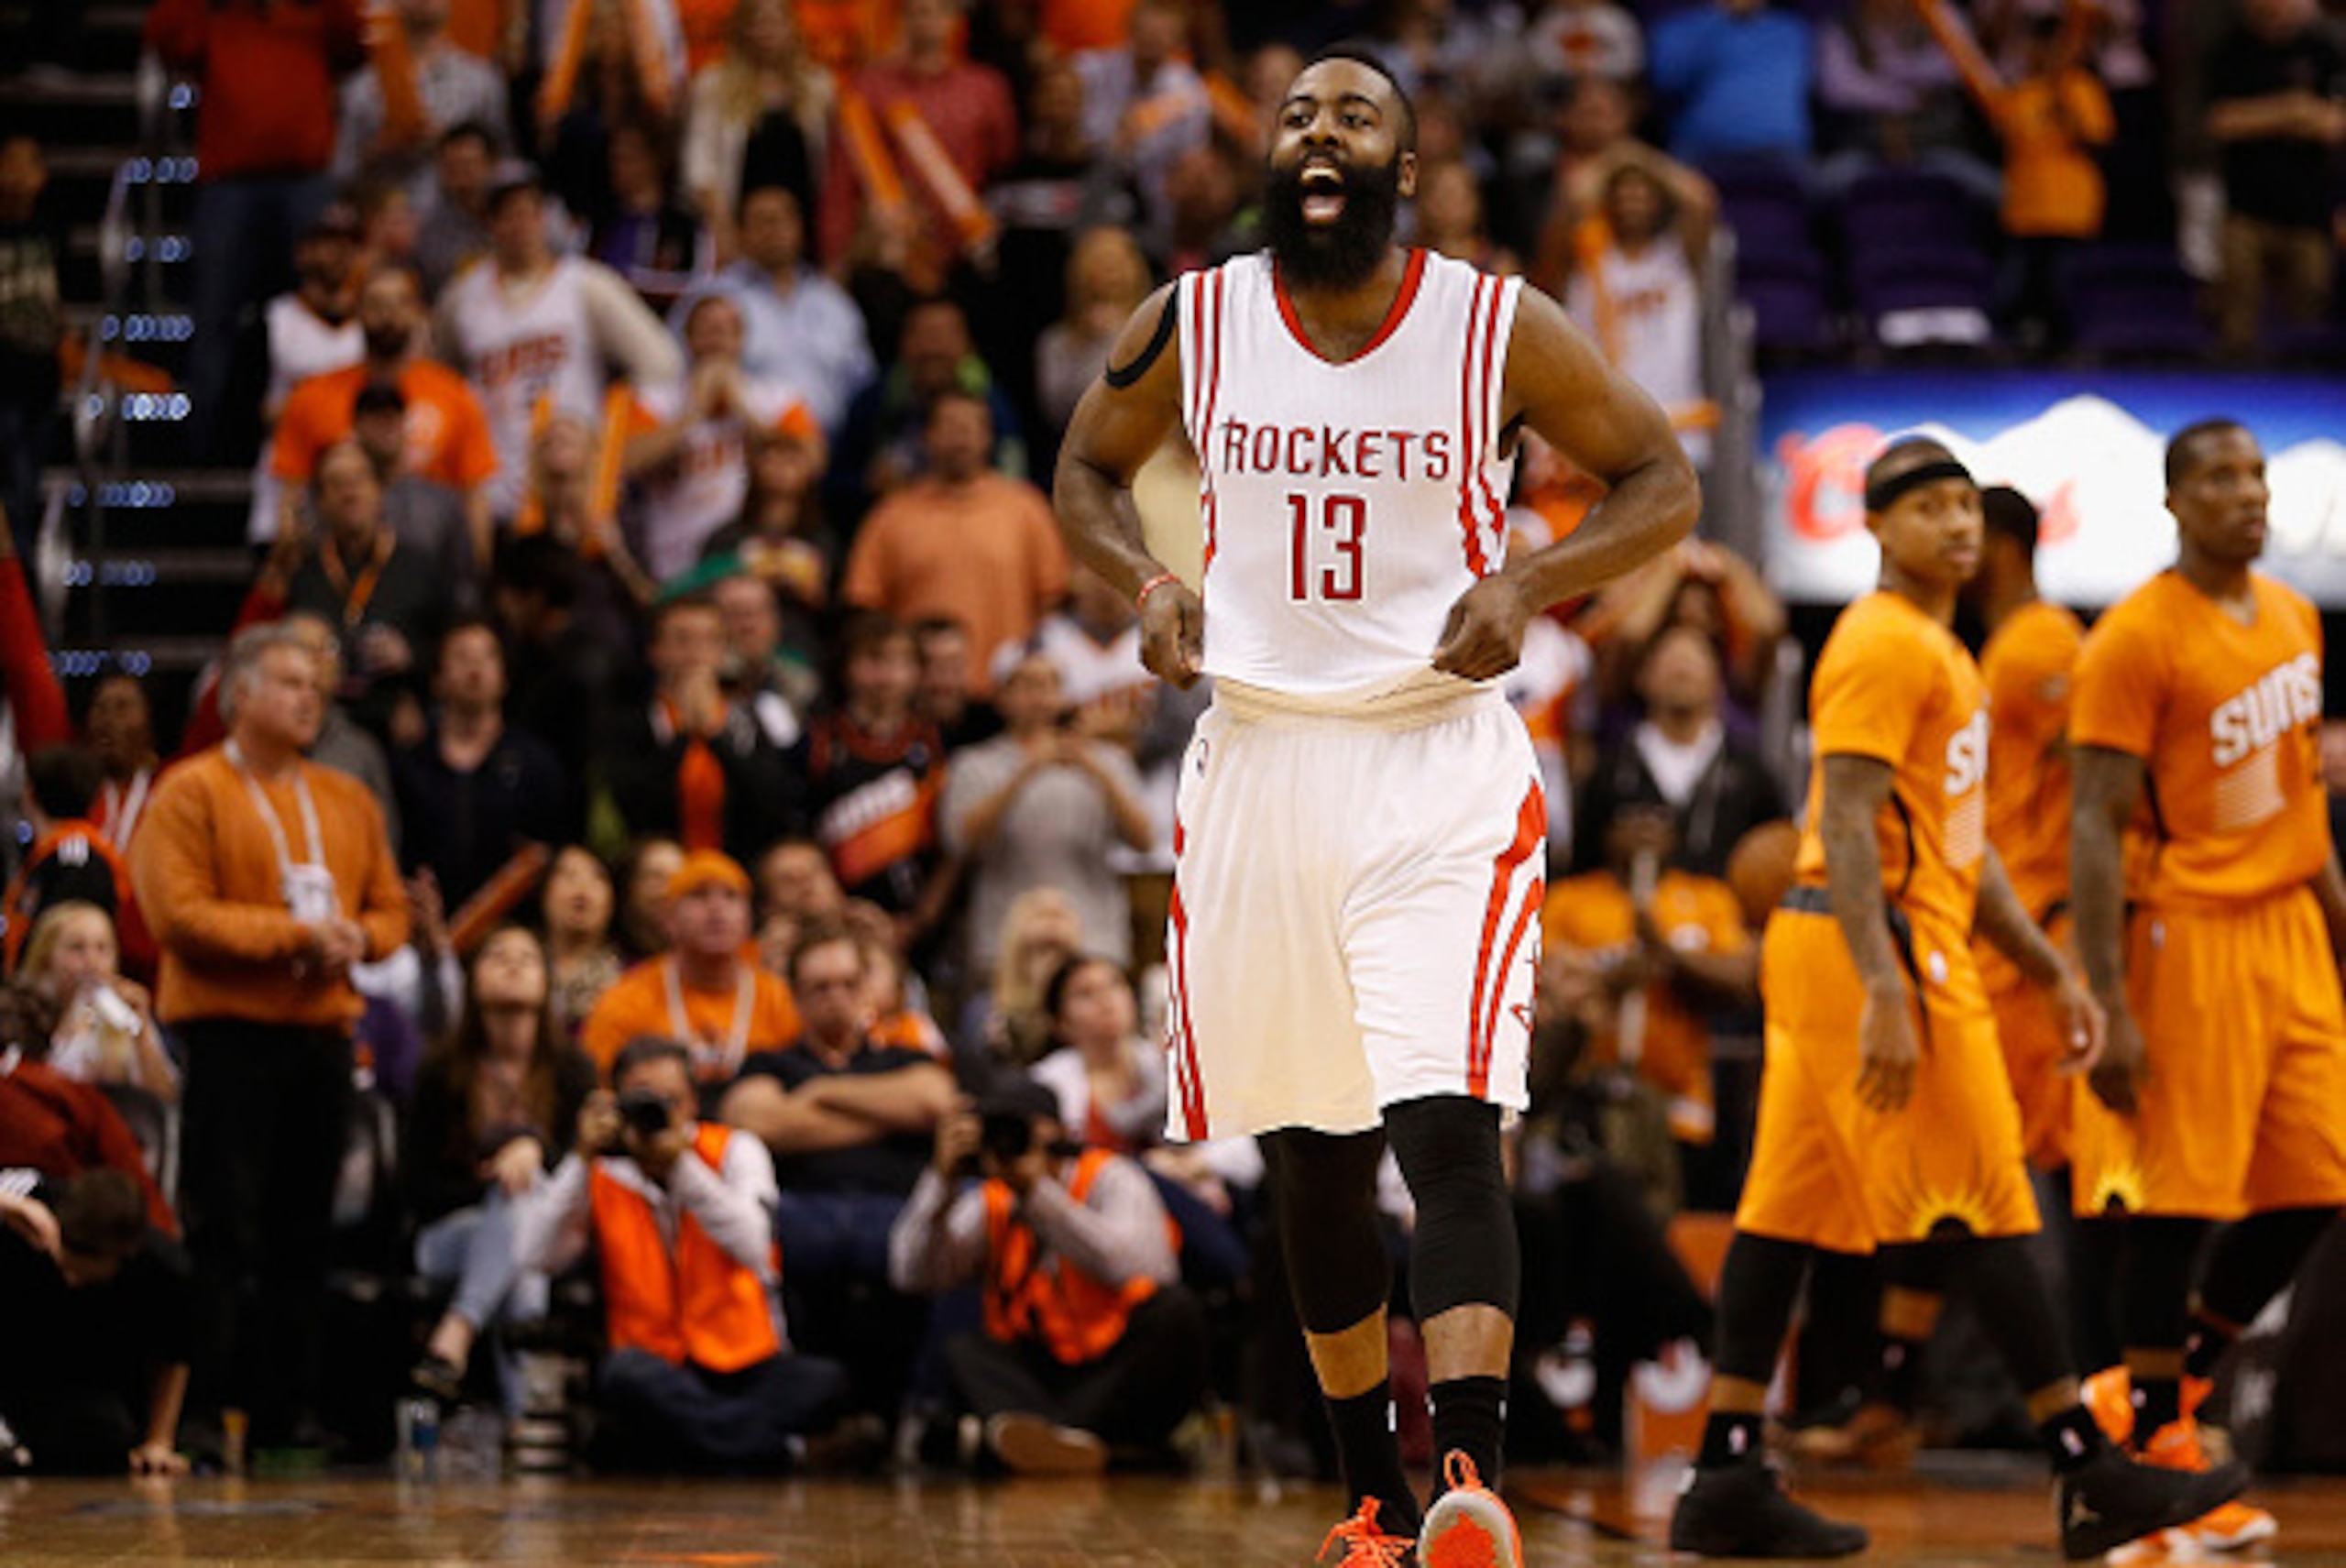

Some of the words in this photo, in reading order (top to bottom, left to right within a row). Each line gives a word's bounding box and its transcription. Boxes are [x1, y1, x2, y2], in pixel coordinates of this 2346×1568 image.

[1220, 415, 1451, 481] ROCKETS
[1287, 493, 1367, 601] 13
[2209, 651, 2324, 767] SUNS
